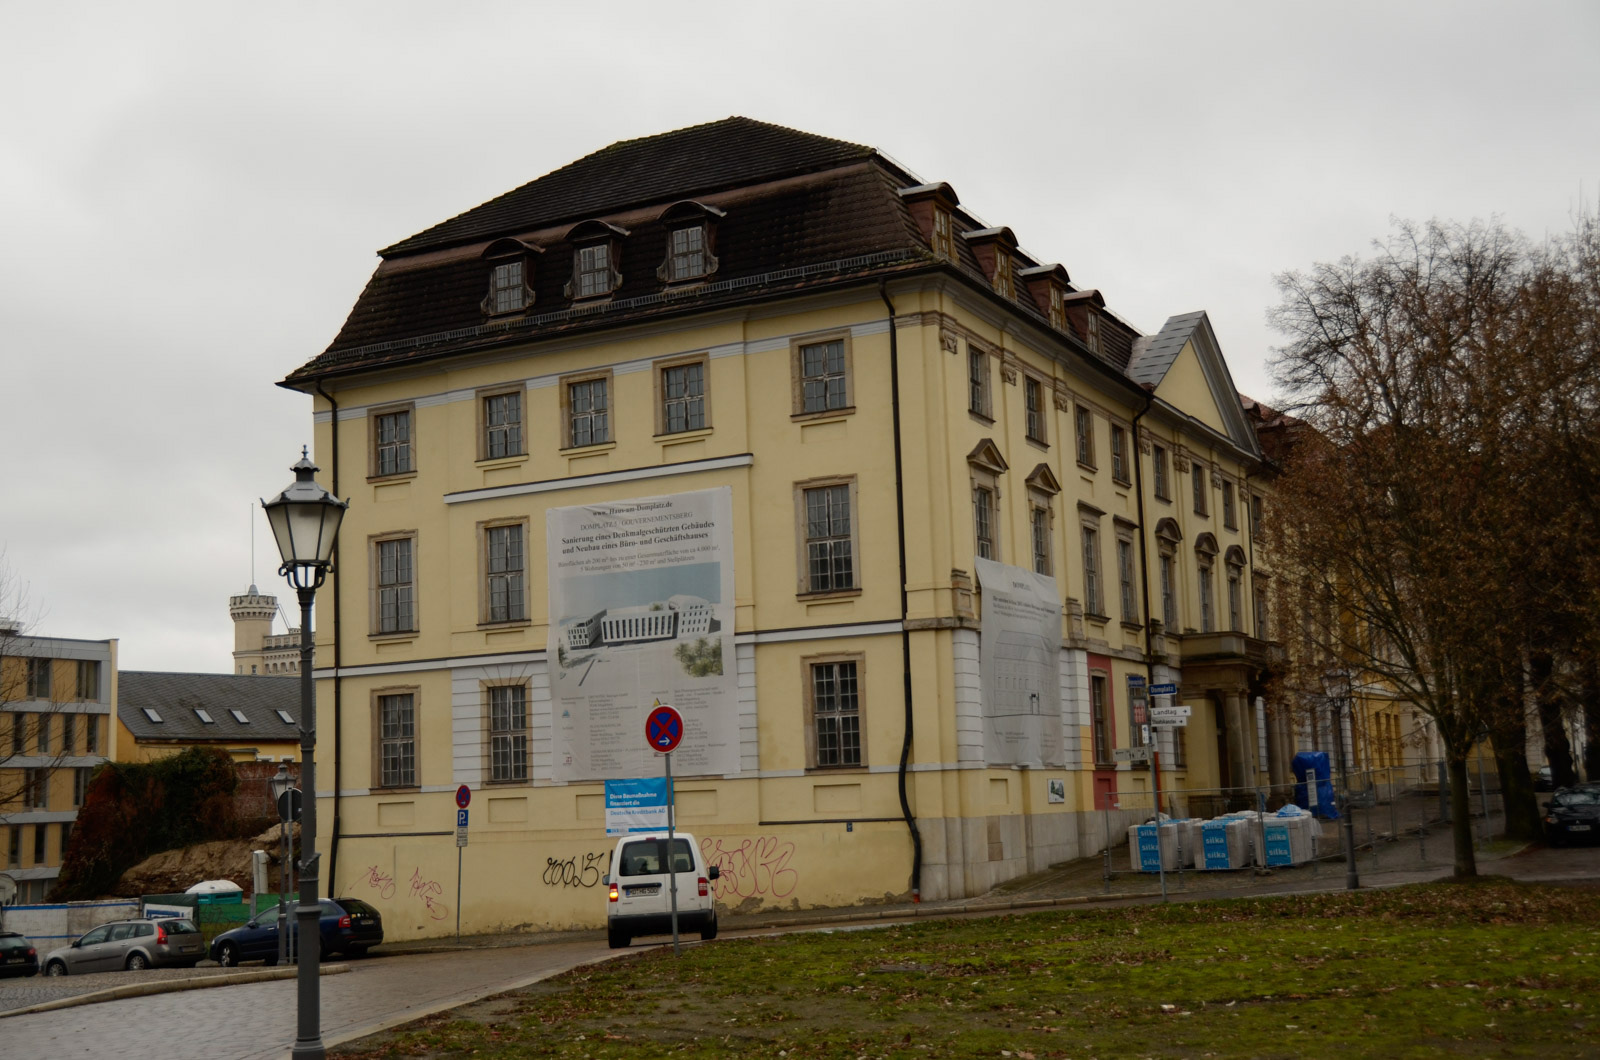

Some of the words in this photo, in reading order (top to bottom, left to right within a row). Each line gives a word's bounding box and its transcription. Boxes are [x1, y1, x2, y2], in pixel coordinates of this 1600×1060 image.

[562, 536, 594, 544] Sanierung
[612, 526, 680, 539] Denkmalgeschützten
[681, 521, 715, 530] Gebäudes
[562, 546, 574, 554] und
[575, 544, 600, 552] Neubau
[639, 537, 652, 545] und
[653, 533, 709, 544] Geschäftshauses
[1150, 685, 1174, 694] Domplatz
[623, 791, 657, 799] Baumaßnahme
[458, 811, 466, 825] P
[1267, 833, 1287, 841] silka
